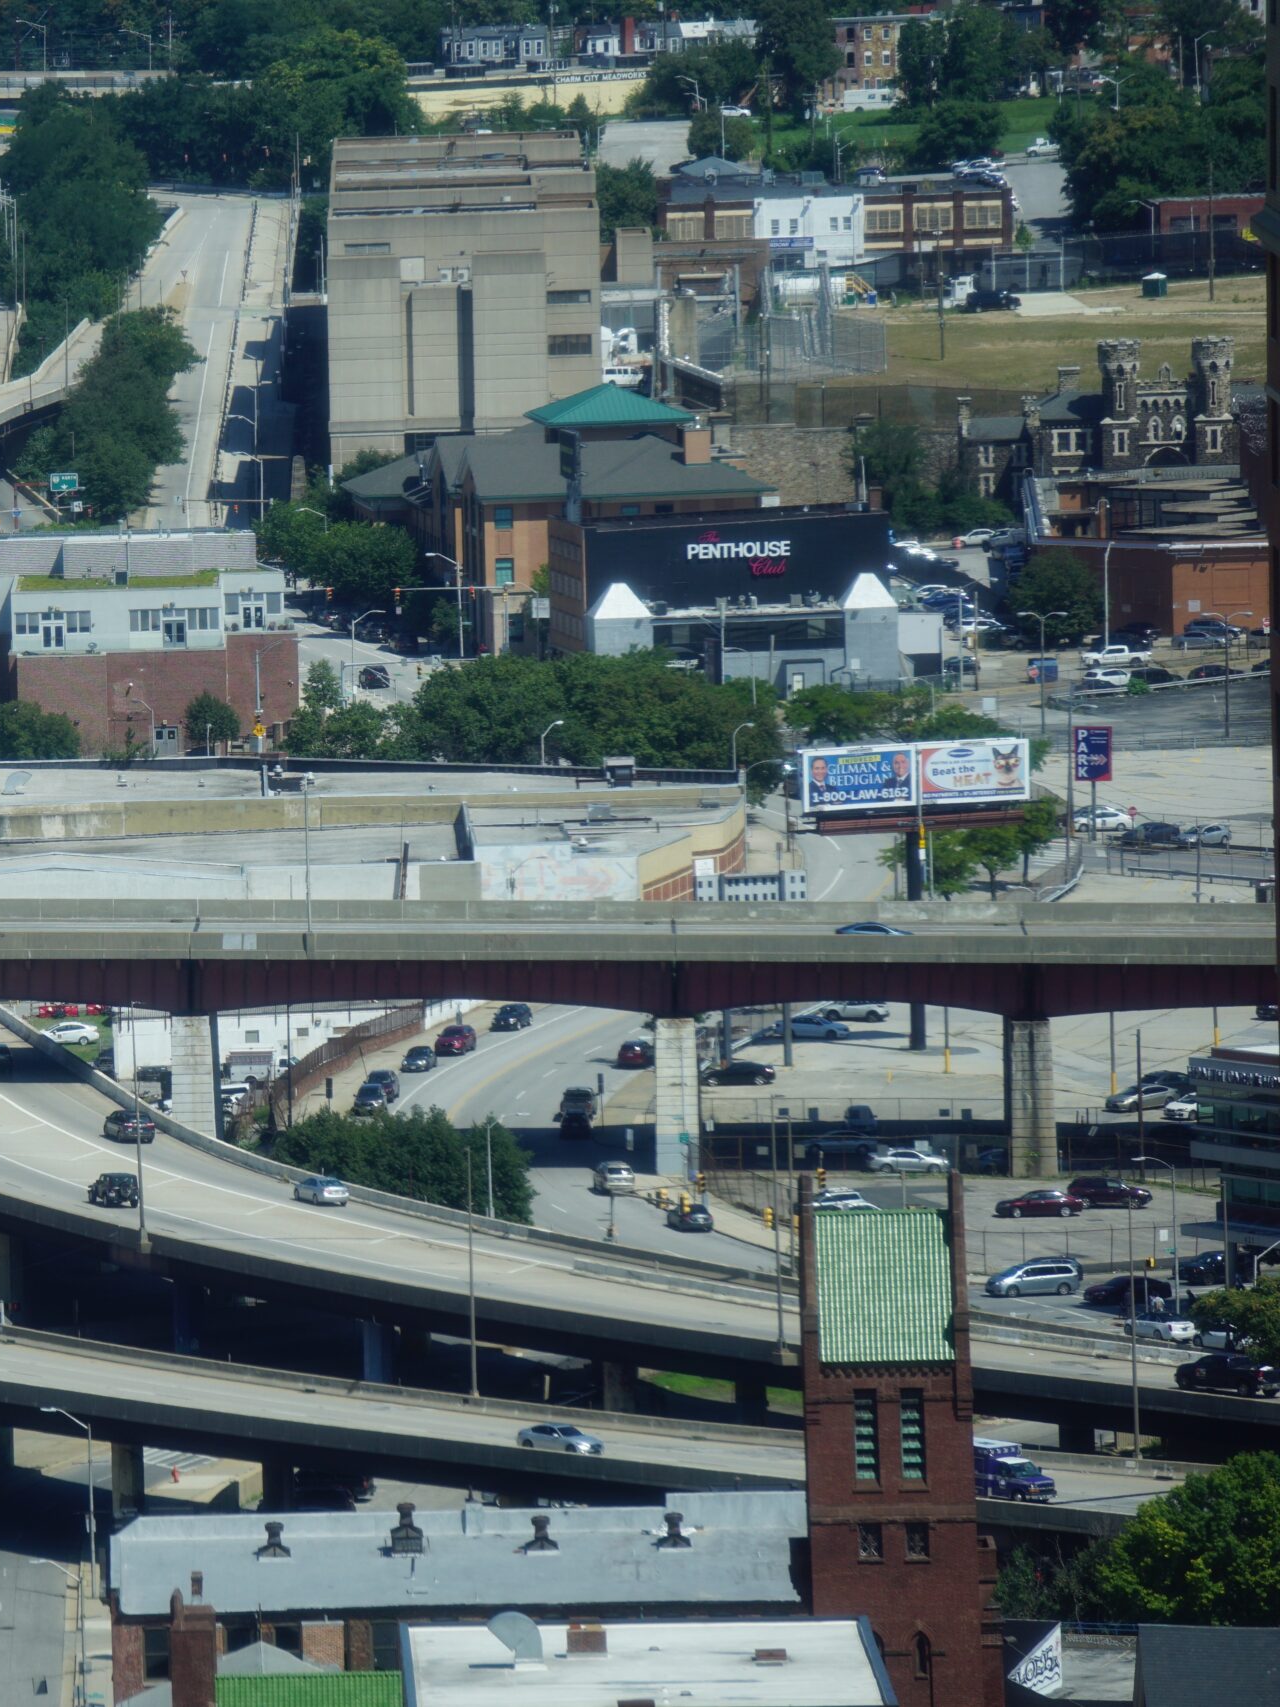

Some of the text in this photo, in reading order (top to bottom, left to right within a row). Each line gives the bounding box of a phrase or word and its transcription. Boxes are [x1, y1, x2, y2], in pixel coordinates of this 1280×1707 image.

[602, 72, 647, 80] MEADWORKS
[687, 541, 791, 560] PENTHOUSE
[749, 556, 786, 576] Club
[1077, 729, 1089, 777] PARK
[828, 760, 892, 775] GILMAN &
[932, 765, 975, 776] Beat the
[829, 773, 893, 786] BEDIGIAN
[953, 772, 992, 787] HEAT
[812, 787, 909, 803] 1-800-LAW-6162
